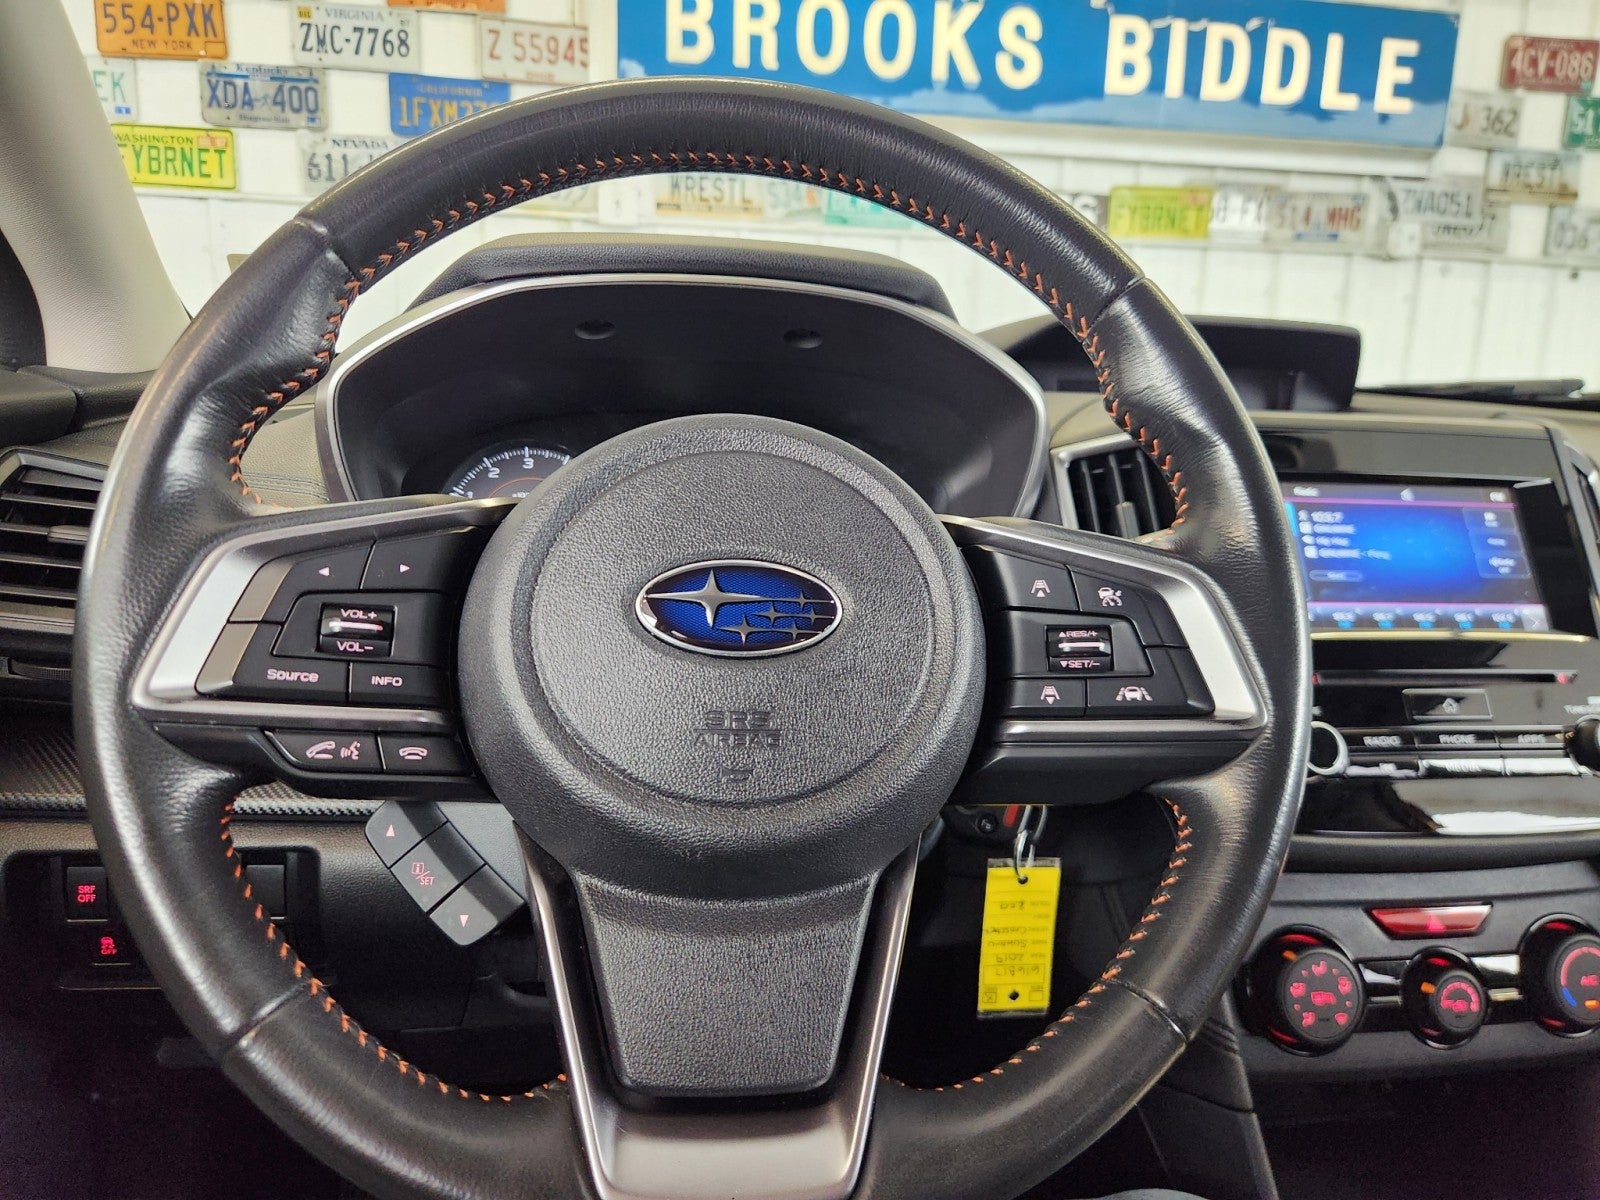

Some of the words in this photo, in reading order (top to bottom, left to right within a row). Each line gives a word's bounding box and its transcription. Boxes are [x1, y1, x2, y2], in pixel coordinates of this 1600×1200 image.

[103, 2, 218, 38] 554-PXK
[325, 7, 385, 21] VIRGINIA
[132, 39, 156, 49] NEW
[164, 39, 193, 50] YORK
[487, 28, 502, 61] Z
[665, 0, 1043, 91] BROOKS
[1104, 14, 1420, 115] BIDDLE
[1510, 46, 1594, 81] 4CV-086
[207, 78, 255, 110] XDA
[272, 84, 320, 114] 400
[1481, 105, 1519, 138] 362
[115, 133, 194, 145] WASHINGTON
[331, 139, 389, 150] NEVADA
[117, 143, 227, 180] YBRNET
[522, 457, 534, 469] 3
[487, 467, 501, 479] 2
[340, 608, 378, 619] VOL+
[336, 640, 374, 653] VOL-
[266, 668, 319, 683] Source
[371, 675, 403, 687] INFO
[705, 710, 771, 729] SRS
[693, 729, 783, 747] AIRBAG
[78, 885, 96, 894] SRF
[77, 894, 96, 903] OFF
